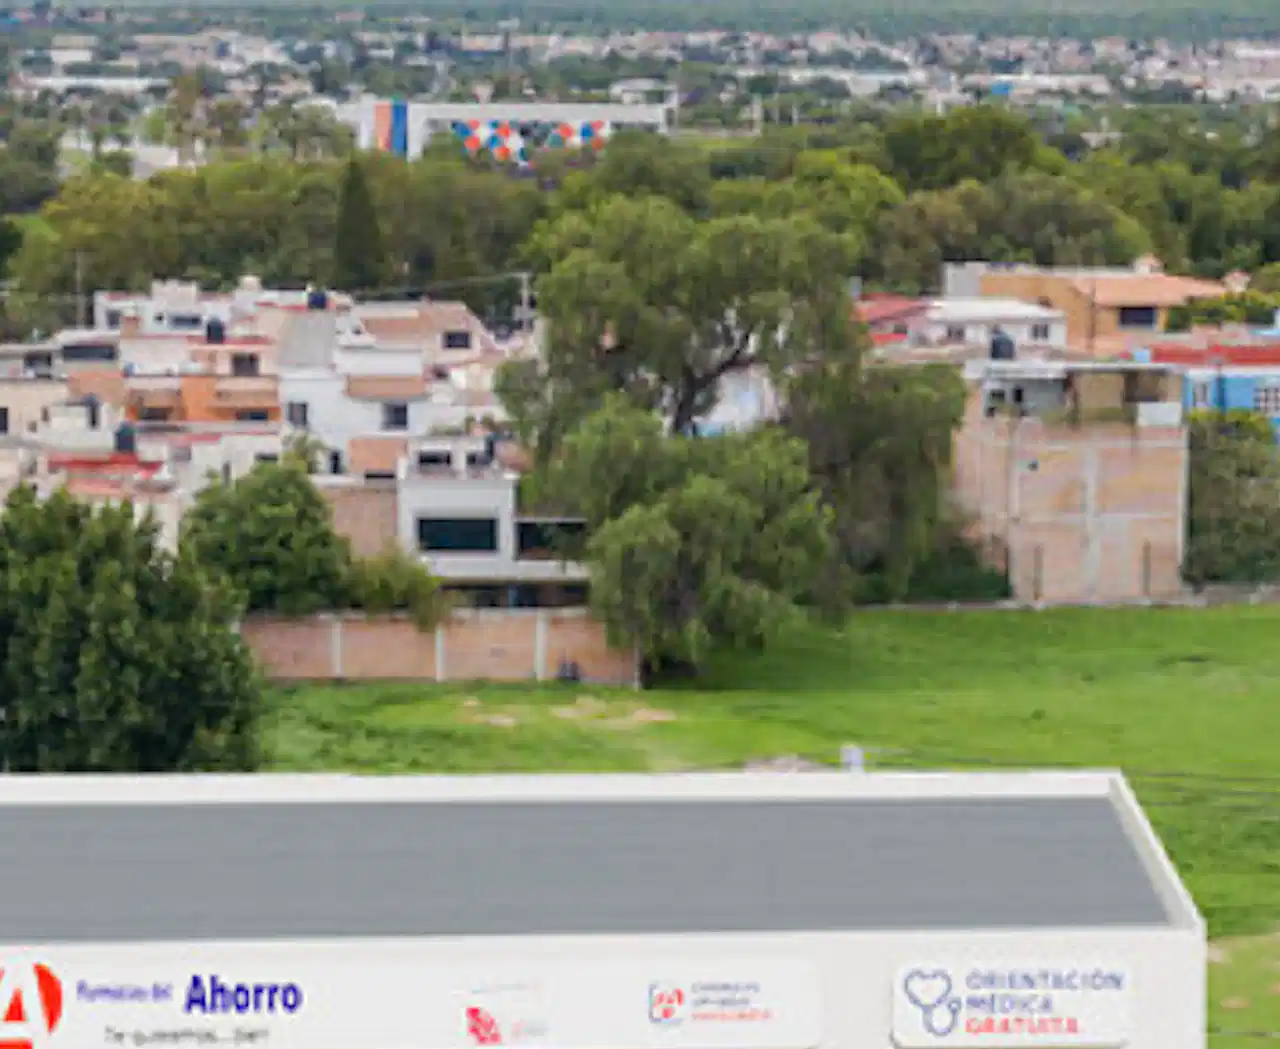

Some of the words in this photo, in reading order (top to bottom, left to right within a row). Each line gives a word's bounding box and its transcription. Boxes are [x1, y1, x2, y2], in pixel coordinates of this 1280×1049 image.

[964, 967, 1126, 991] ORIENTACIÓN
[183, 974, 303, 1014] Ahorro
[964, 1016, 1080, 1035] GRATUITA
